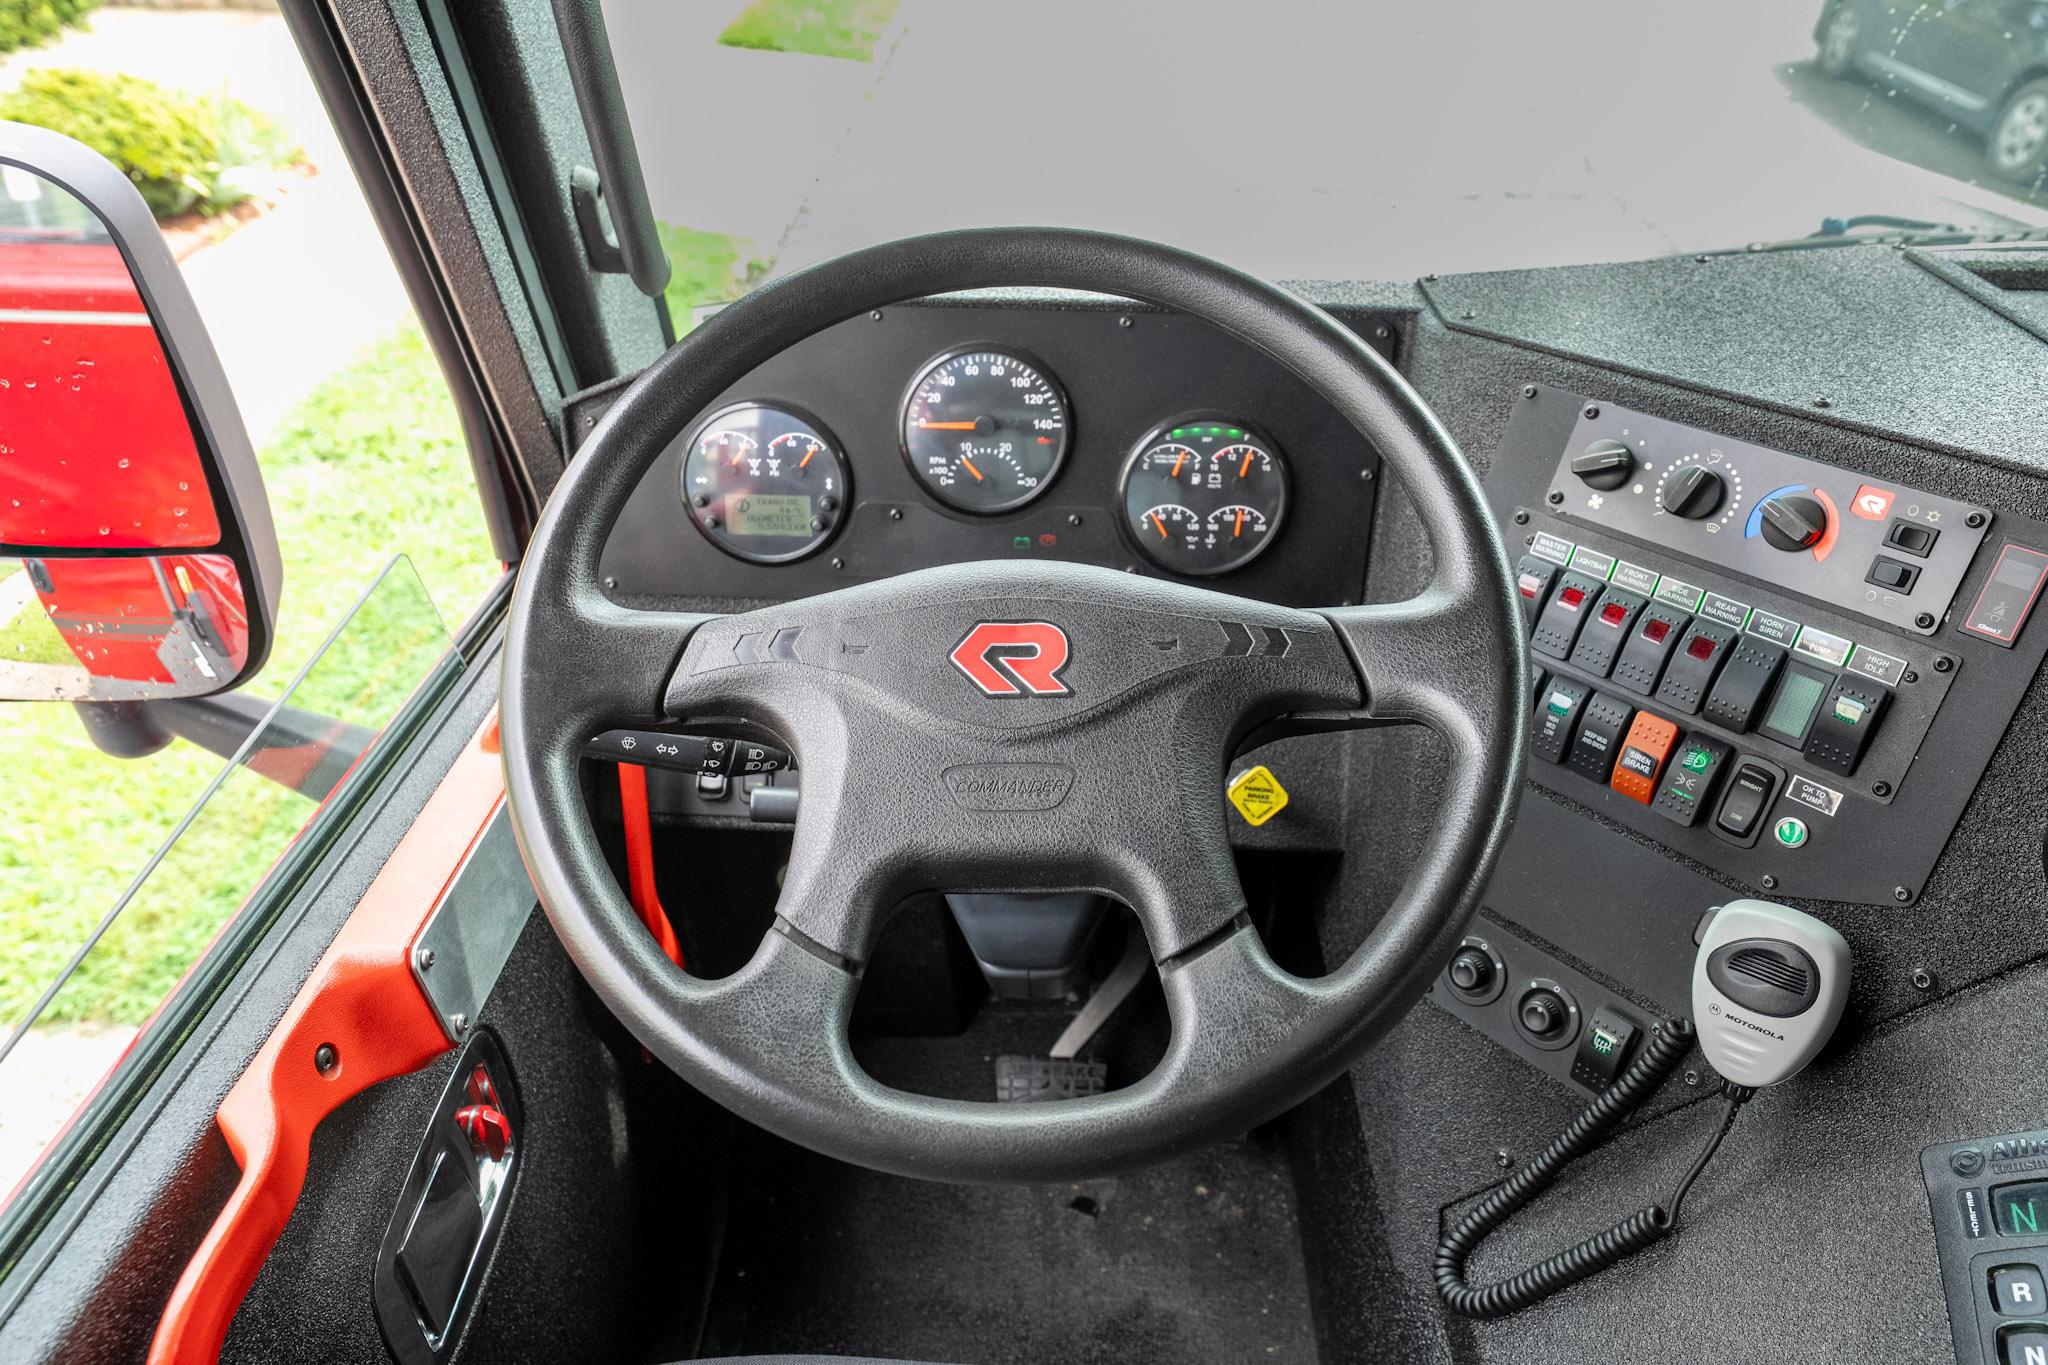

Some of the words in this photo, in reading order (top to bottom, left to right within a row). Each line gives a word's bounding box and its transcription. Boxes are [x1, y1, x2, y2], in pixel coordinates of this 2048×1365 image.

[965, 366, 979, 376] 60
[991, 366, 1004, 376] 80
[941, 376, 955, 386] 40
[1010, 377, 1031, 388] 100
[928, 393, 941, 403] 20
[1024, 394, 1043, 405] 120
[1033, 419, 1053, 430] 140
[960, 442, 972, 450] 10
[999, 443, 1012, 452] 20
[929, 456, 947, 464] RPM
[940, 477, 947, 486] 0
[1024, 478, 1037, 487] 30
[1535, 543, 1566, 560] WARNING
[1540, 537, 1567, 553] MASTER
[1576, 555, 1608, 572] LIGHTBAR
[1623, 568, 1649, 580] FRONT
[1617, 573, 1650, 591] WARNING
[1672, 585, 1689, 596] SIDE
[1660, 590, 1695, 607] WARNING
[1715, 601, 1738, 614] REAR
[1705, 605, 1742, 624] WARNING
[1760, 616, 1784, 631] HORN
[1758, 625, 1784, 639] SIREN
[1809, 643, 1832, 654] PUMP
[1867, 654, 1890, 668] HIGH
[1864, 663, 1886, 676] IDLE
[1543, 727, 1555, 736] LOW
[1545, 721, 1557, 730] MED
[1581, 736, 1593, 746] AND
[1592, 740, 1607, 751] SNOW
[1584, 729, 1596, 739] DEEP
[1596, 734, 1608, 745] MUD
[1629, 750, 1652, 766] SIREN
[1624, 757, 1651, 774] BRAKE
[956, 780, 1066, 792] COMMANDER
[1739, 778, 1763, 793] BRIGHT
[1802, 784, 1816, 795] OK
[1816, 789, 1826, 799] TO
[1801, 792, 1823, 806] PUMP
[1730, 811, 1743, 821] DIM
[1725, 1013, 1784, 1041] MOTOROLA
[1965, 1192, 1980, 1237] SELECT
[2011, 1201, 2039, 1233] N
[2011, 1282, 2033, 1302] R
[2024, 1346, 2045, 1365] N
